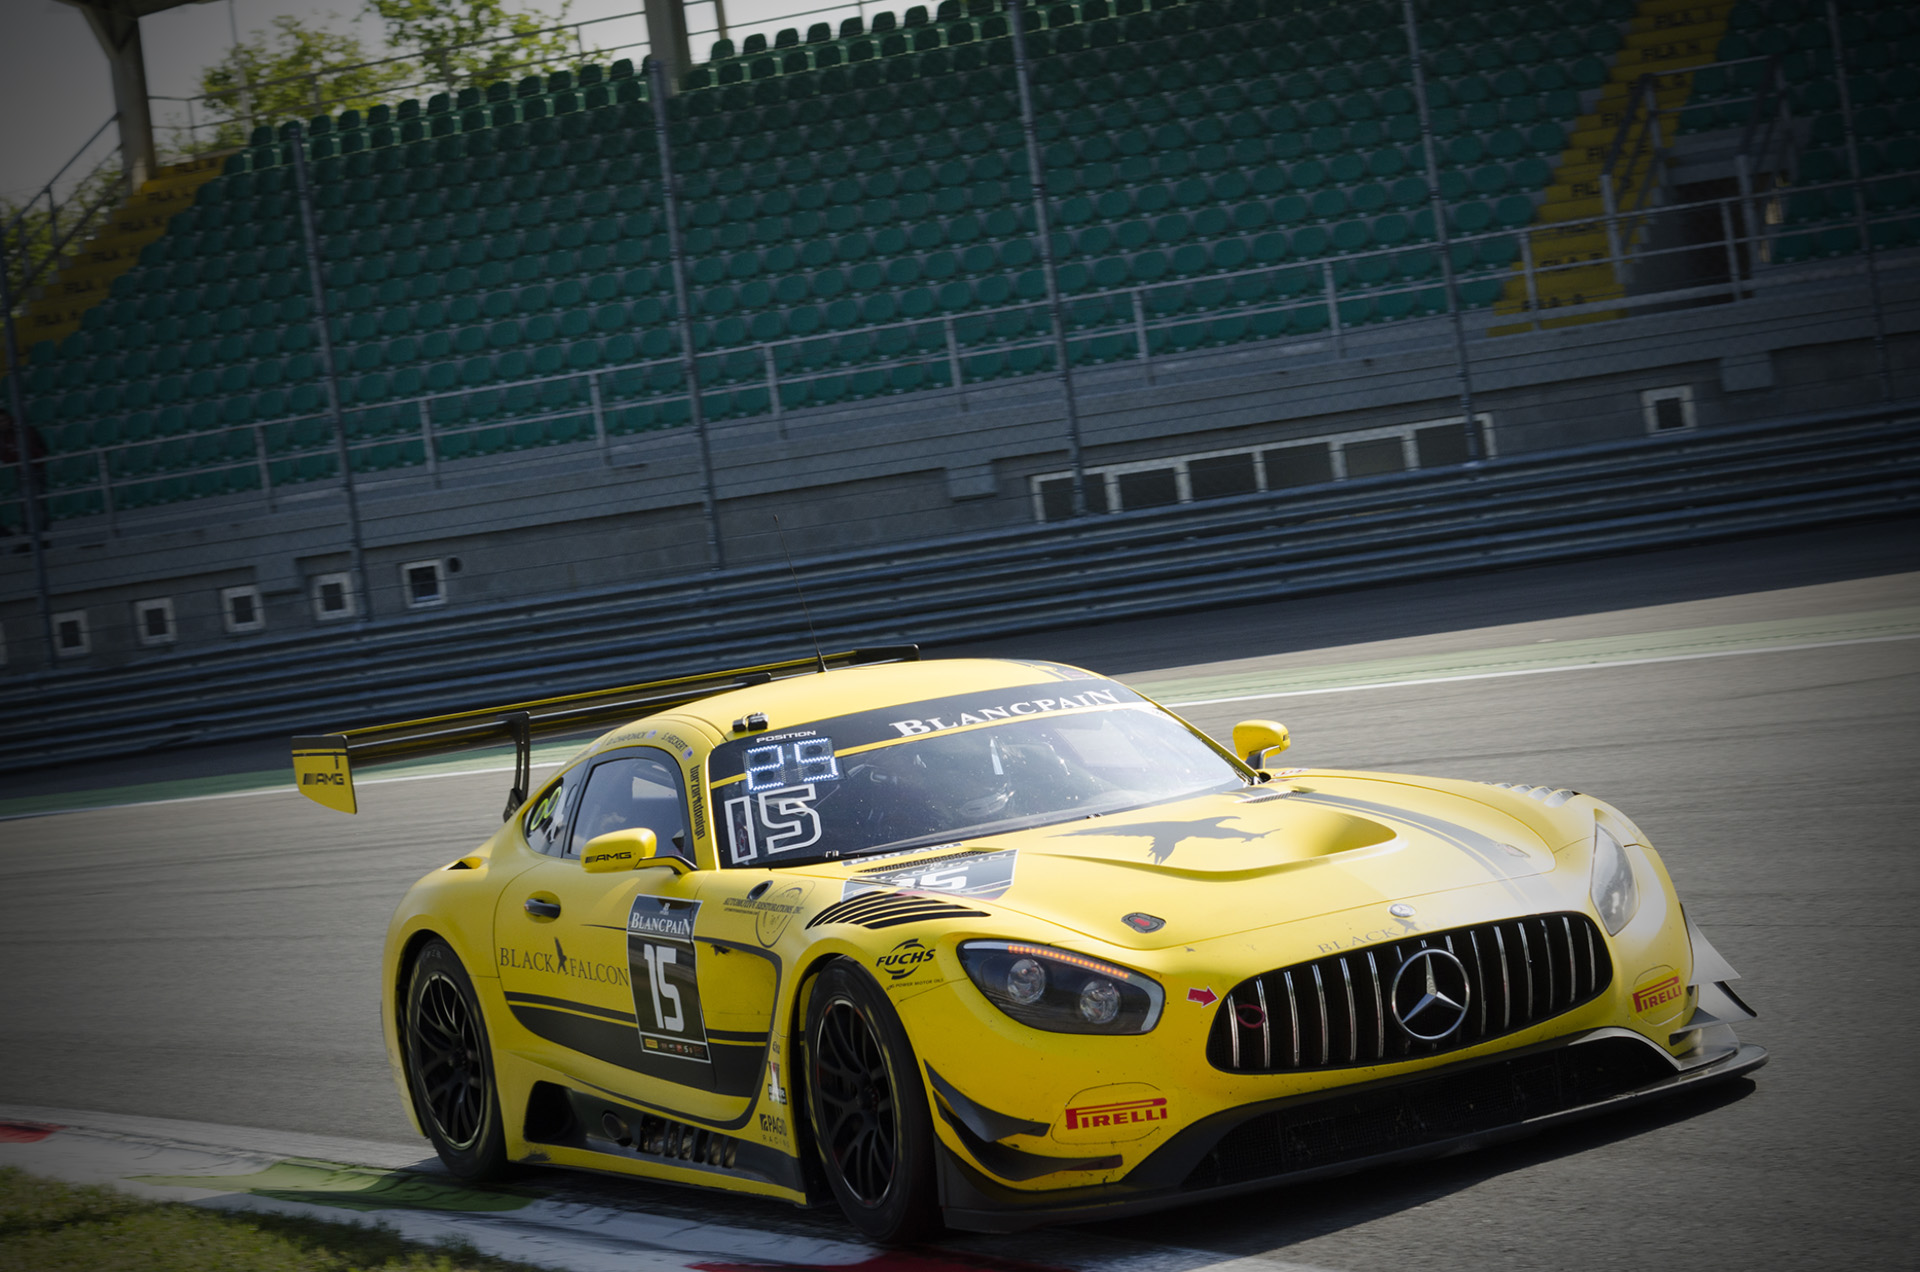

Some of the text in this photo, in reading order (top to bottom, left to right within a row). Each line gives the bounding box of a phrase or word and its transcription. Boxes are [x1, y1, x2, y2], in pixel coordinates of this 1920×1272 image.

[889, 688, 1120, 737] BLANCPAIN
[756, 730, 817, 743] POSITION
[313, 771, 344, 786] AMG
[724, 783, 823, 864] 15
[595, 851, 632, 862] AMG
[631, 912, 690, 935] BLANCPAIN
[1317, 927, 1400, 954] BLACK
[500, 947, 629, 986] BLACK FALCON
[876, 948, 936, 967] FUCHS
[644, 944, 684, 1032] 15
[1632, 975, 1682, 1013] PIRELLI
[1065, 1097, 1167, 1131] PIRELLI
